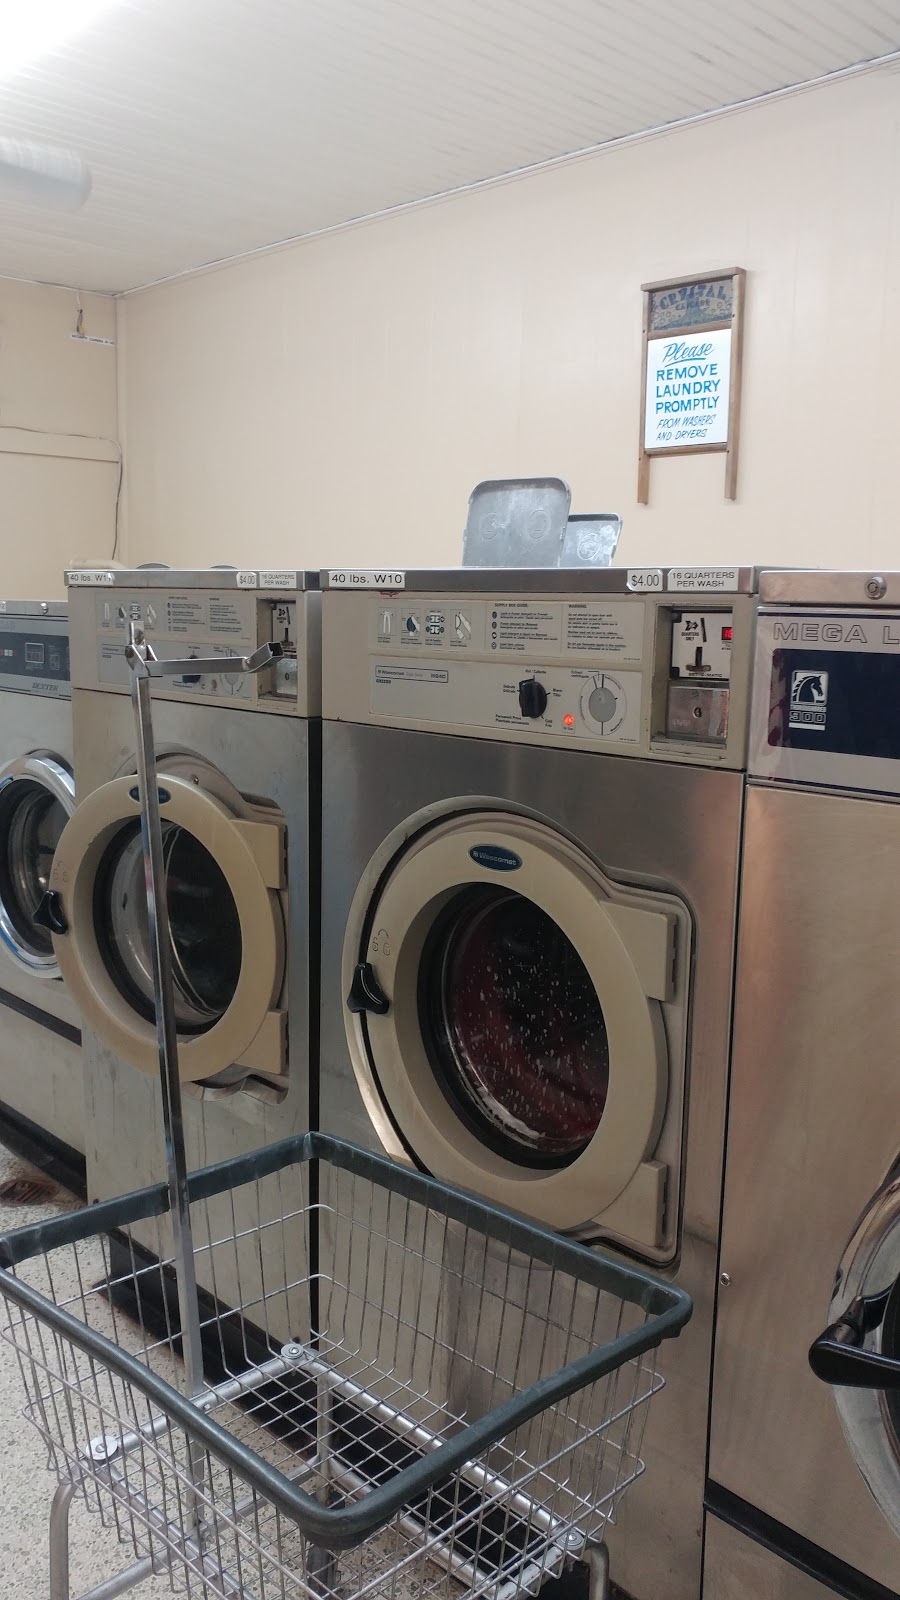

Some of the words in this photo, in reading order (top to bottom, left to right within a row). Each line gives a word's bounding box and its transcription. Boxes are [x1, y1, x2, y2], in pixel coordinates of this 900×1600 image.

[659, 284, 726, 310] CRYSTAL
[662, 342, 715, 363] Please
[656, 363, 718, 381] REMOVE
[656, 379, 721, 398] LAUNDRY
[655, 396, 720, 414] PROMPTLY
[656, 417, 681, 429] FROM
[682, 414, 717, 427] WASHERS
[656, 431, 672, 441] AND
[675, 428, 708, 440] DRYERS
[239, 575, 256, 585] $4.00
[331, 573, 346, 583] 40
[349, 574, 370, 584] lbs.
[373, 574, 403, 584] W10
[631, 574, 660, 587] $4.00
[684, 571, 736, 579] QUARTERS
[773, 622, 868, 643] MEGA
[32, 682, 59, 692] DEXTER
[479, 852, 517, 866] Wascomat
